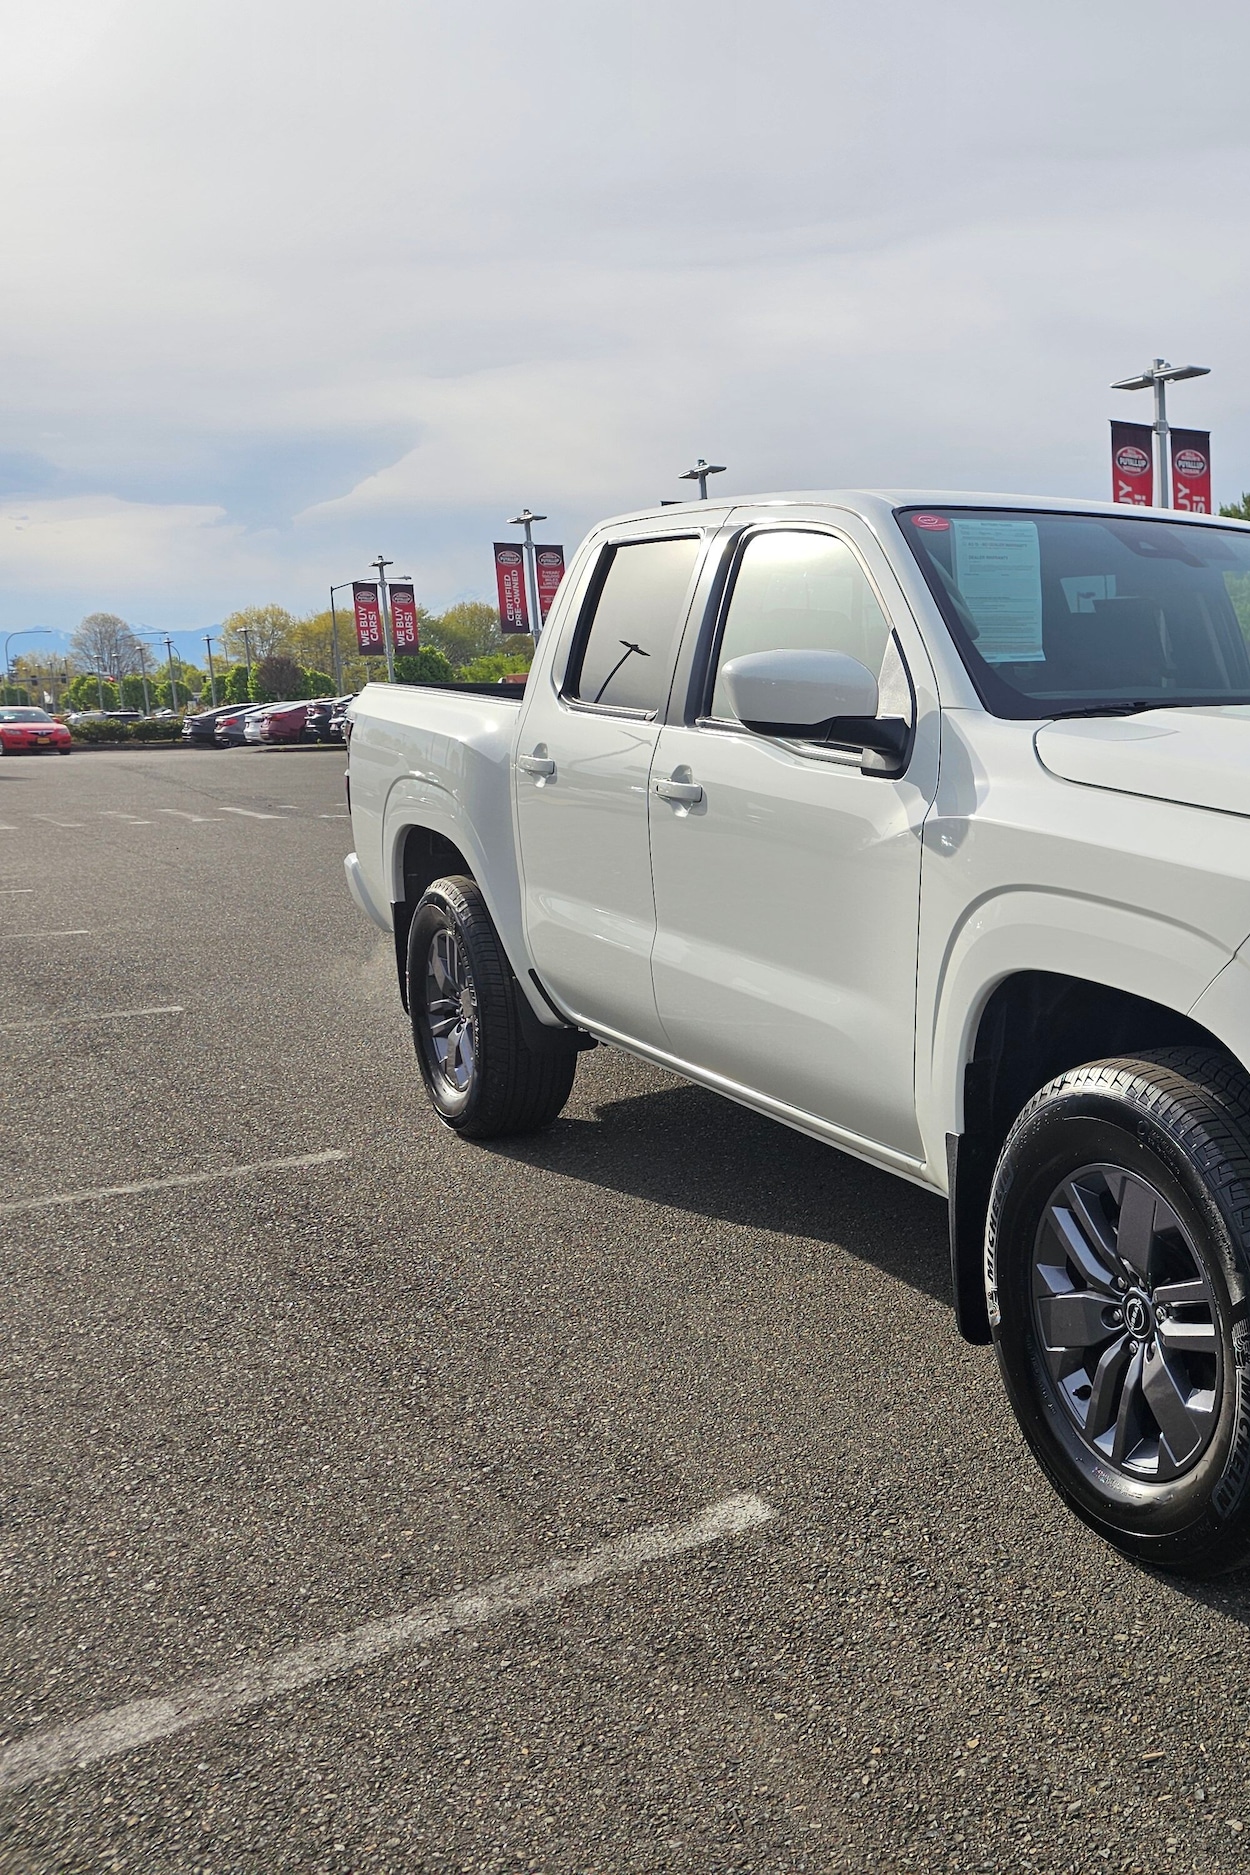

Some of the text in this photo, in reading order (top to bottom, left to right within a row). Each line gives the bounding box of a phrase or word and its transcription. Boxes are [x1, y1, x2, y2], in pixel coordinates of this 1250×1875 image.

[1119, 457, 1146, 467] PUYALLUP
[1178, 460, 1204, 470] PUYALLUP
[1118, 480, 1133, 504] UY
[1177, 482, 1191, 511] UY
[503, 574, 514, 621] CERTIFIED
[511, 569, 523, 627] PRE-OWNED
[358, 606, 370, 646] WE BUY
[368, 611, 379, 642] CARS!
[394, 607, 405, 646] WE BUY
[404, 612, 414, 642] CARS!
